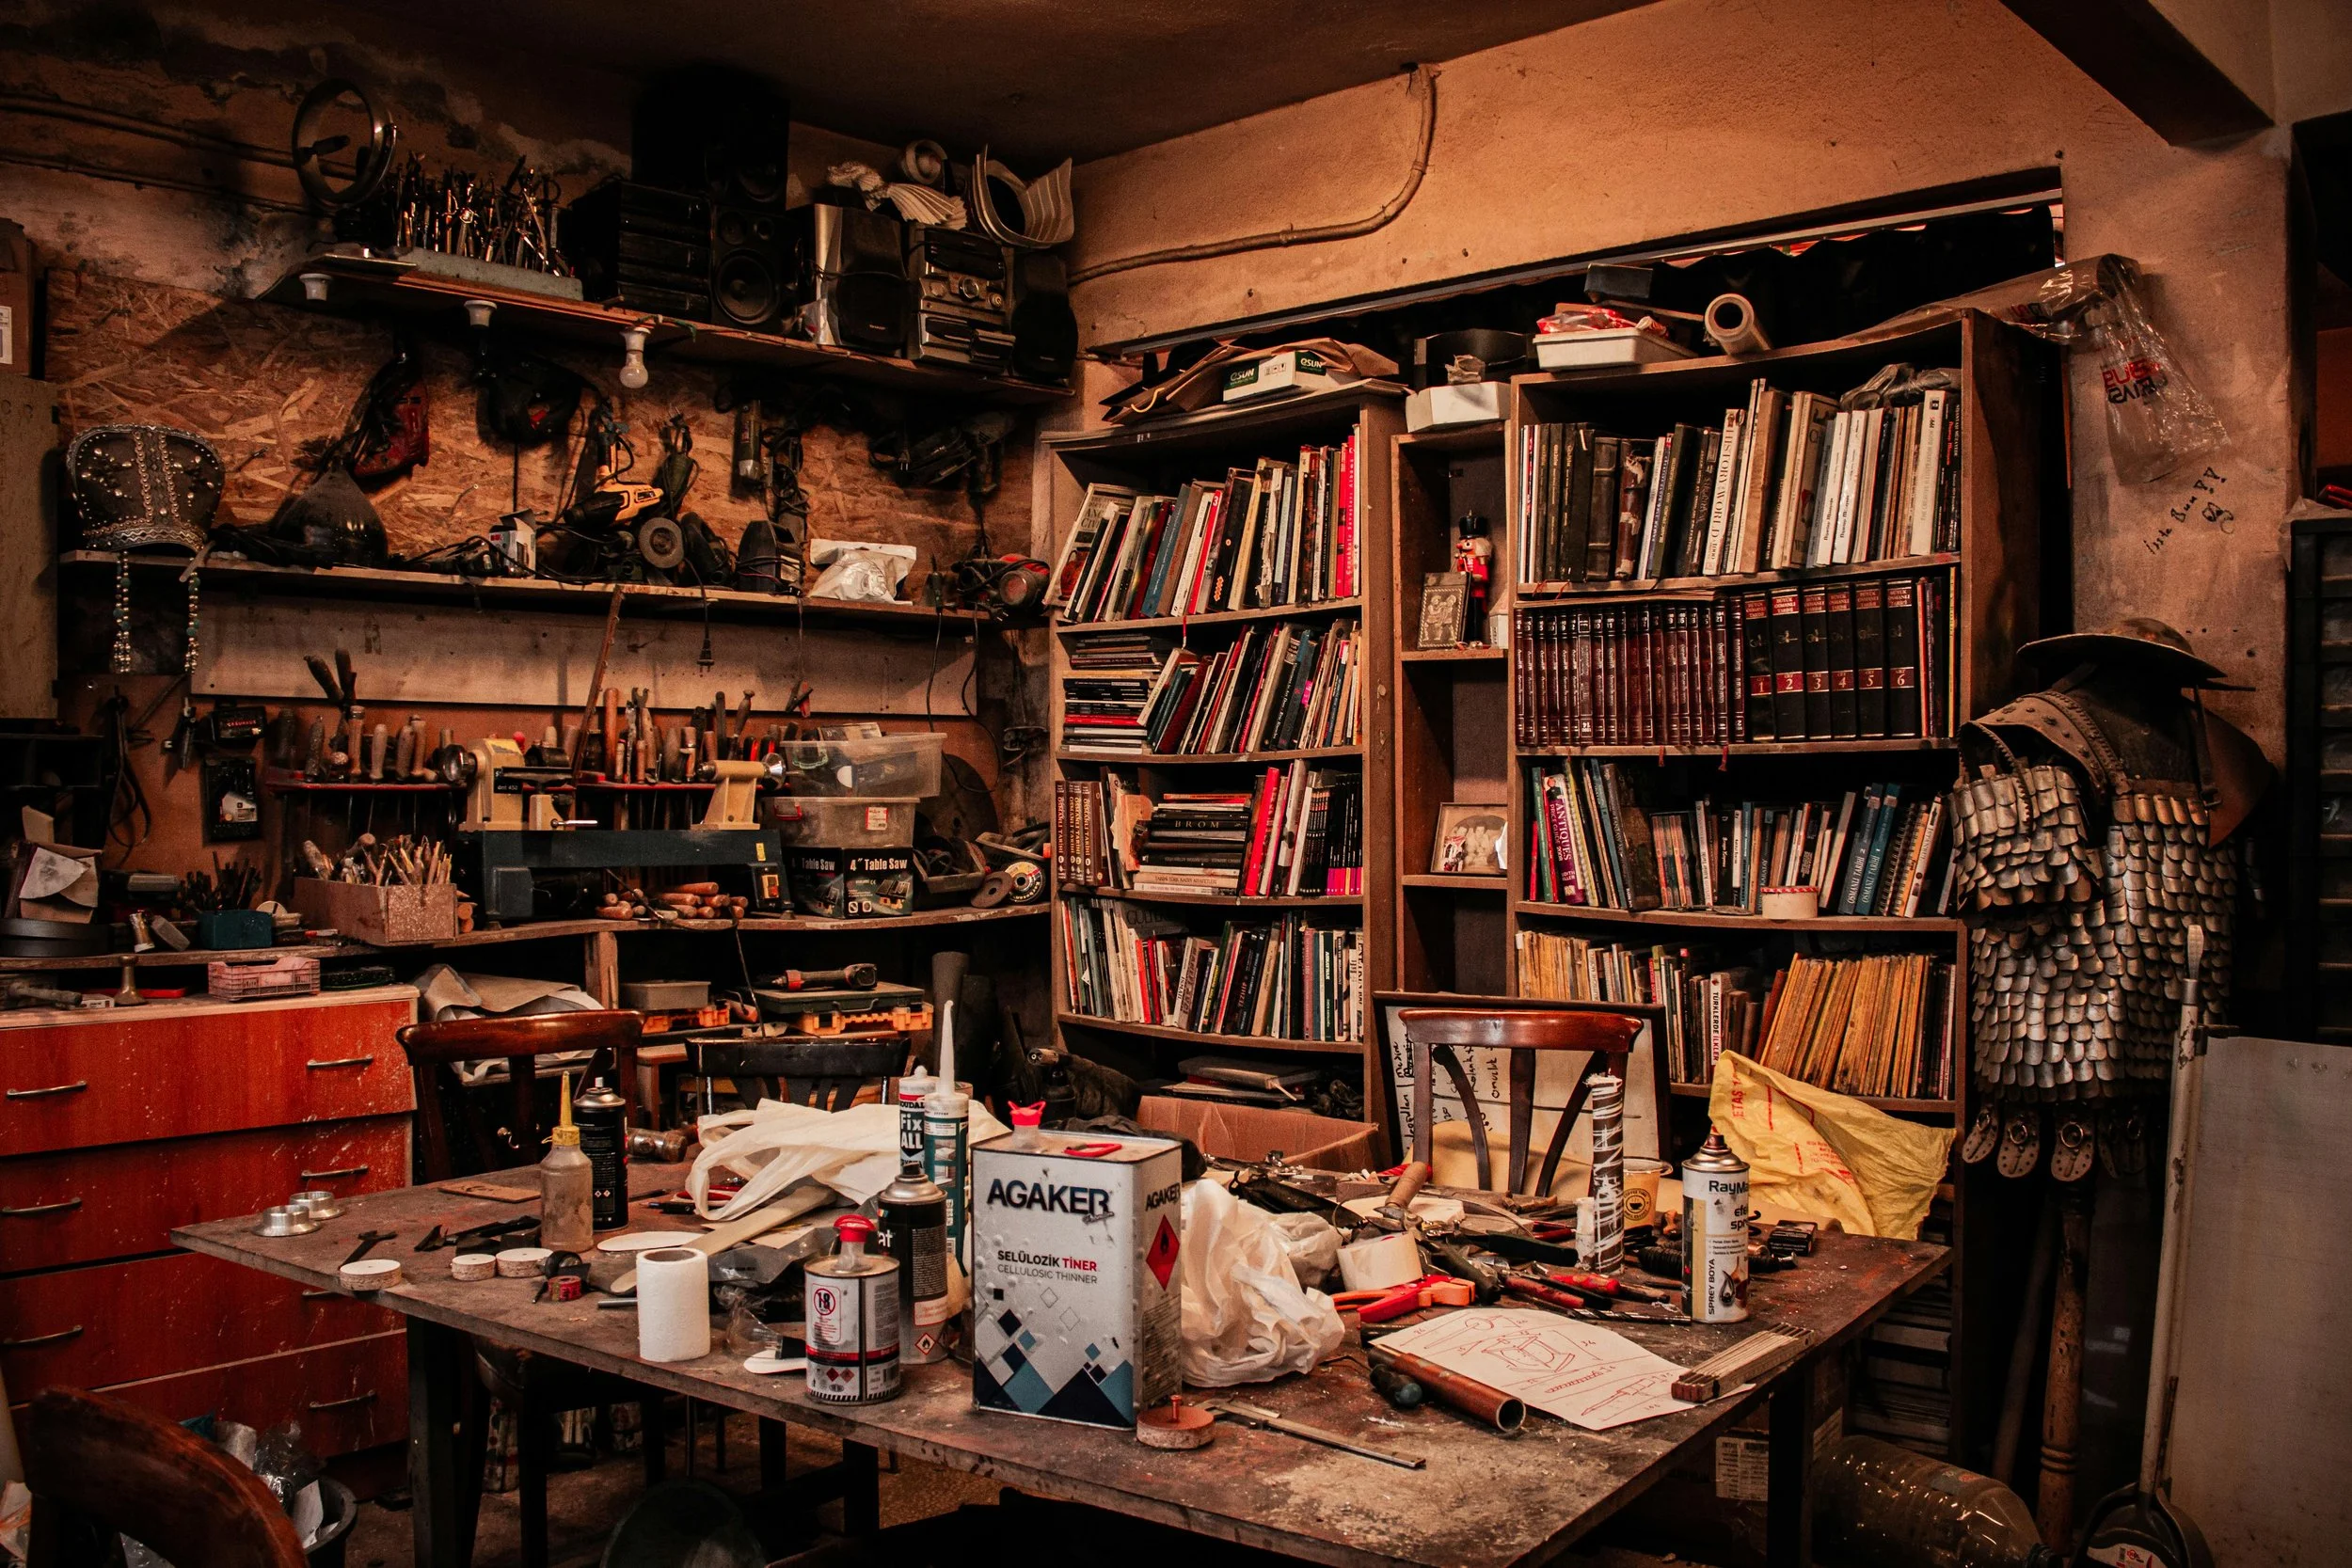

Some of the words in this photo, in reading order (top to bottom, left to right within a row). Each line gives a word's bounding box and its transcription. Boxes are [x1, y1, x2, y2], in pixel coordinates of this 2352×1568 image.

[1718, 427, 1733, 485] HISTORY
[1213, 495, 1219, 506] 3
[1709, 488, 1725, 538] WORLD
[1759, 682, 1764, 692] 1
[1786, 678, 1793, 689] 2
[1814, 678, 1821, 689] 3
[1838, 676, 1847, 688] 4
[1867, 675, 1873, 687] 5
[1897, 673, 1905, 686] 6
[1175, 820, 1219, 829] BROM
[1555, 802, 1572, 861] ANTIQUES
[802, 858, 820, 870] Table
[820, 859, 835, 871] Saw
[865, 858, 887, 871] Table
[889, 858, 908, 870] Saw
[1851, 855, 1865, 876] TARİHİ
[1867, 854, 1880, 876] TARİHİ
[1846, 877, 1860, 904] OSMANLI
[1861, 876, 1874, 903] OSMANLI
[1711, 991, 1720, 1034] TÜRKLERDE
[1712, 1035, 1721, 1061] İLKLER
[901, 1113, 923, 1132] Fix
[901, 1132, 923, 1149] ALL
[987, 1178, 1111, 1214] AGAKER
[1145, 1182, 1181, 1212] AGAKER
[1708, 1180, 1749, 1195] RayMa
[997, 1249, 1060, 1268] SELÜLOZİK
[1062, 1257, 1097, 1272] TİNER
[997, 1264, 1054, 1279] CELLULOSIC
[1055, 1271, 1098, 1284] THINNER
[1707, 1285, 1715, 1314] SPREY
